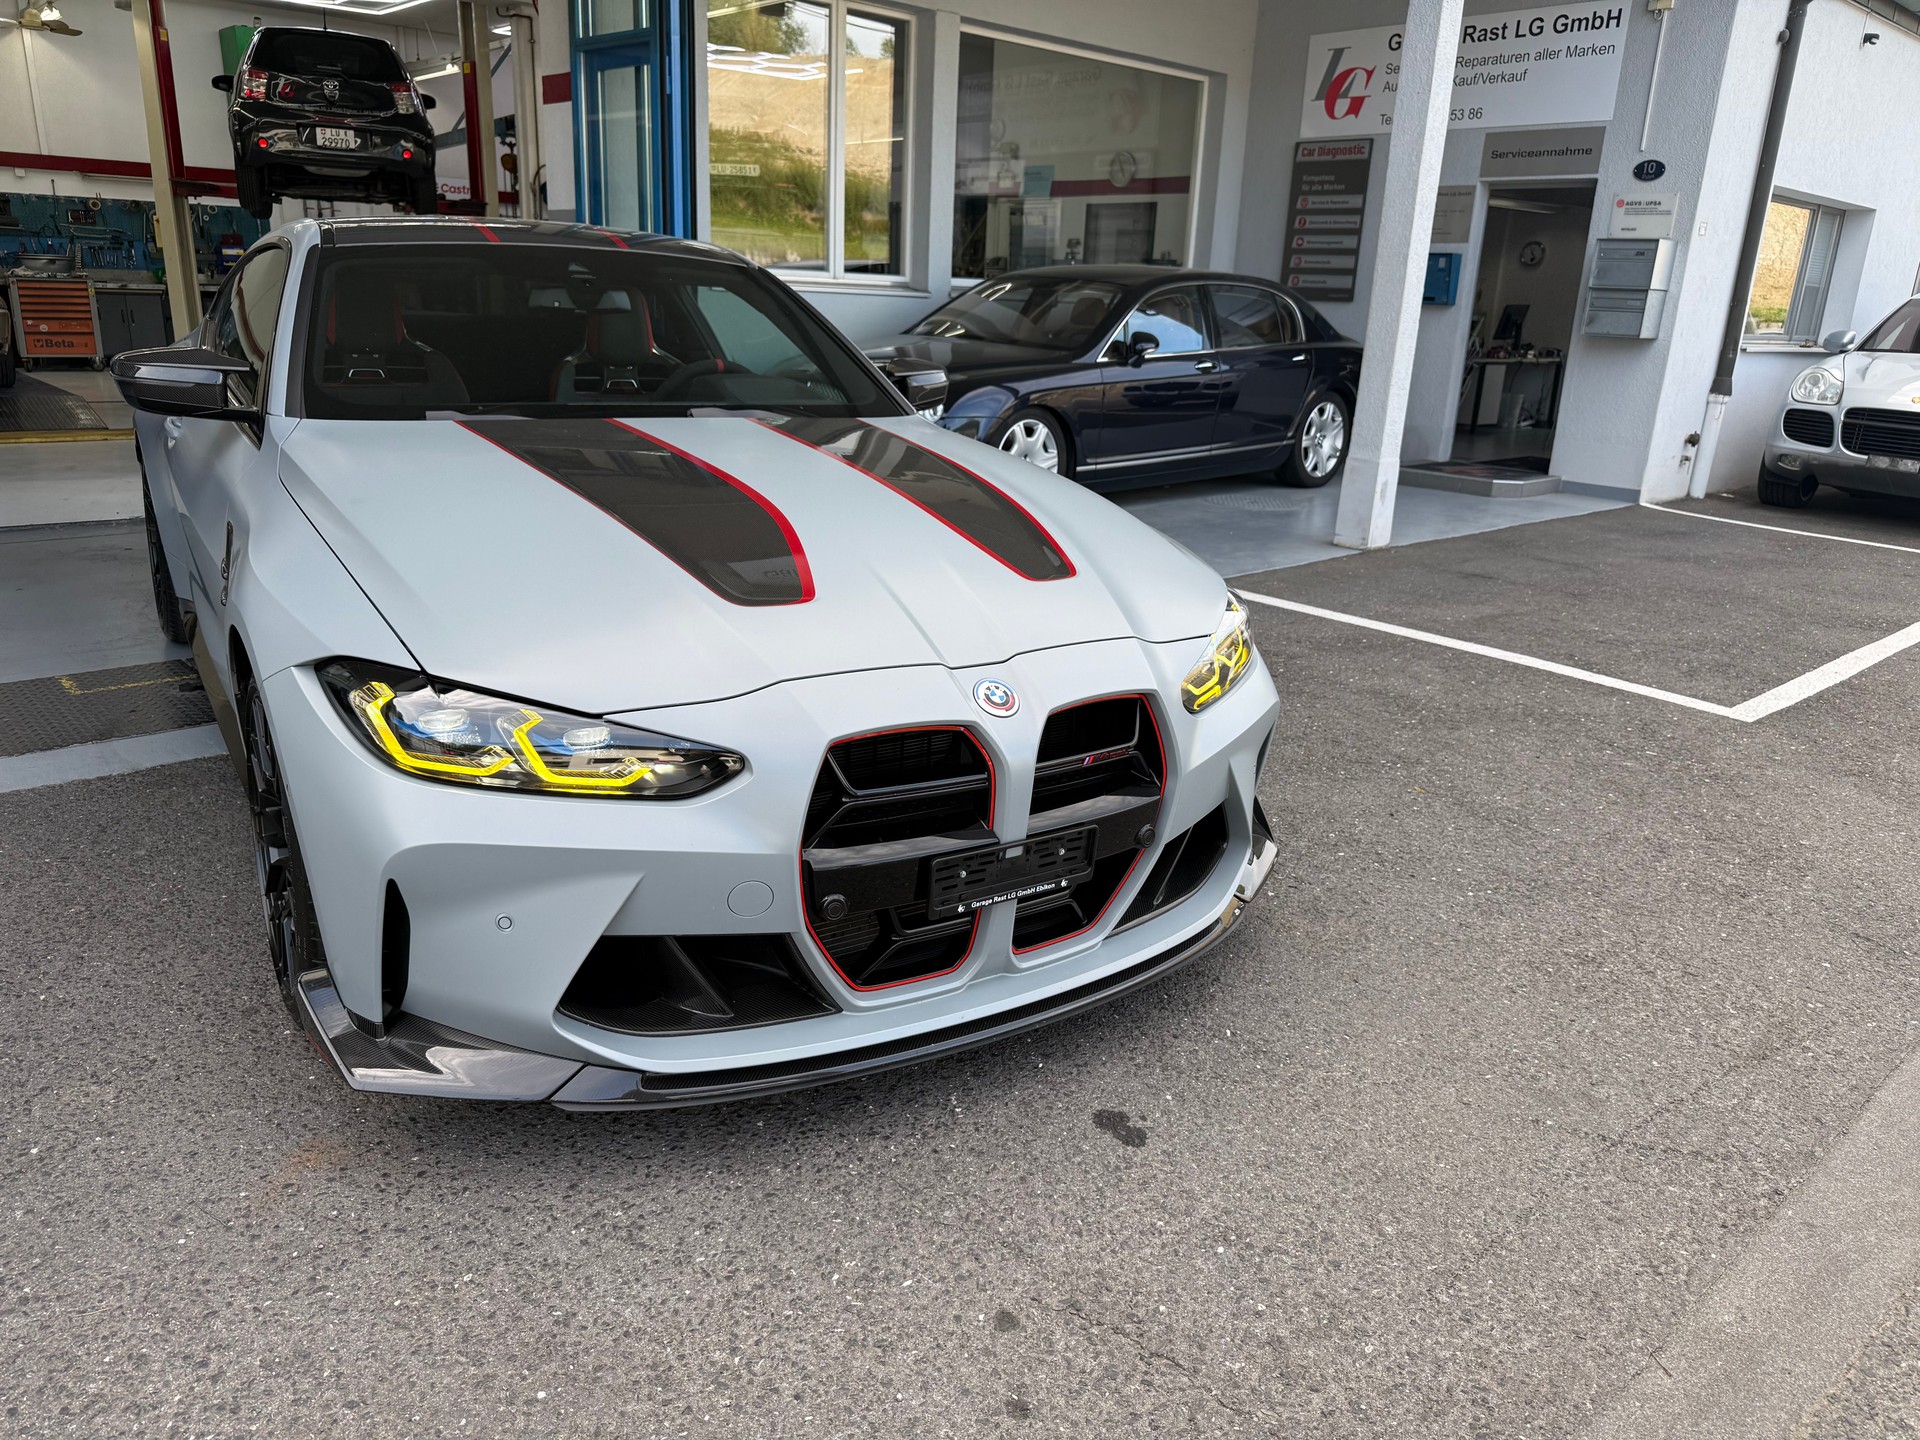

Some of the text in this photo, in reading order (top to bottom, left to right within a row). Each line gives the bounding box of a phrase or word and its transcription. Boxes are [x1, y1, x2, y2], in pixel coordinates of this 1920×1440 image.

[1462, 22, 1508, 44] Rast
[1514, 17, 1545, 39] LG
[1552, 8, 1623, 34] GmbH
[1455, 51, 1530, 70] Reparaturen
[1534, 48, 1563, 62] aller
[1565, 43, 1616, 59] Marken
[1450, 108, 1465, 121] 53
[1468, 107, 1483, 120] 86
[330, 129, 340, 137] LU
[321, 136, 351, 149] 29970
[1301, 144, 1366, 159] Car Diagnostic
[1490, 146, 1593, 160] Serviceannahme
[1643, 162, 1656, 174] 10
[441, 183, 470, 195] Castr
[45, 339, 74, 348] Beta
[971, 898, 993, 908] Garage
[993, 894, 1007, 903] Rast
[1007, 891, 1016, 899] LG
[1017, 887, 1036, 897] GmbH
[1036, 883, 1055, 892] Ebikon
